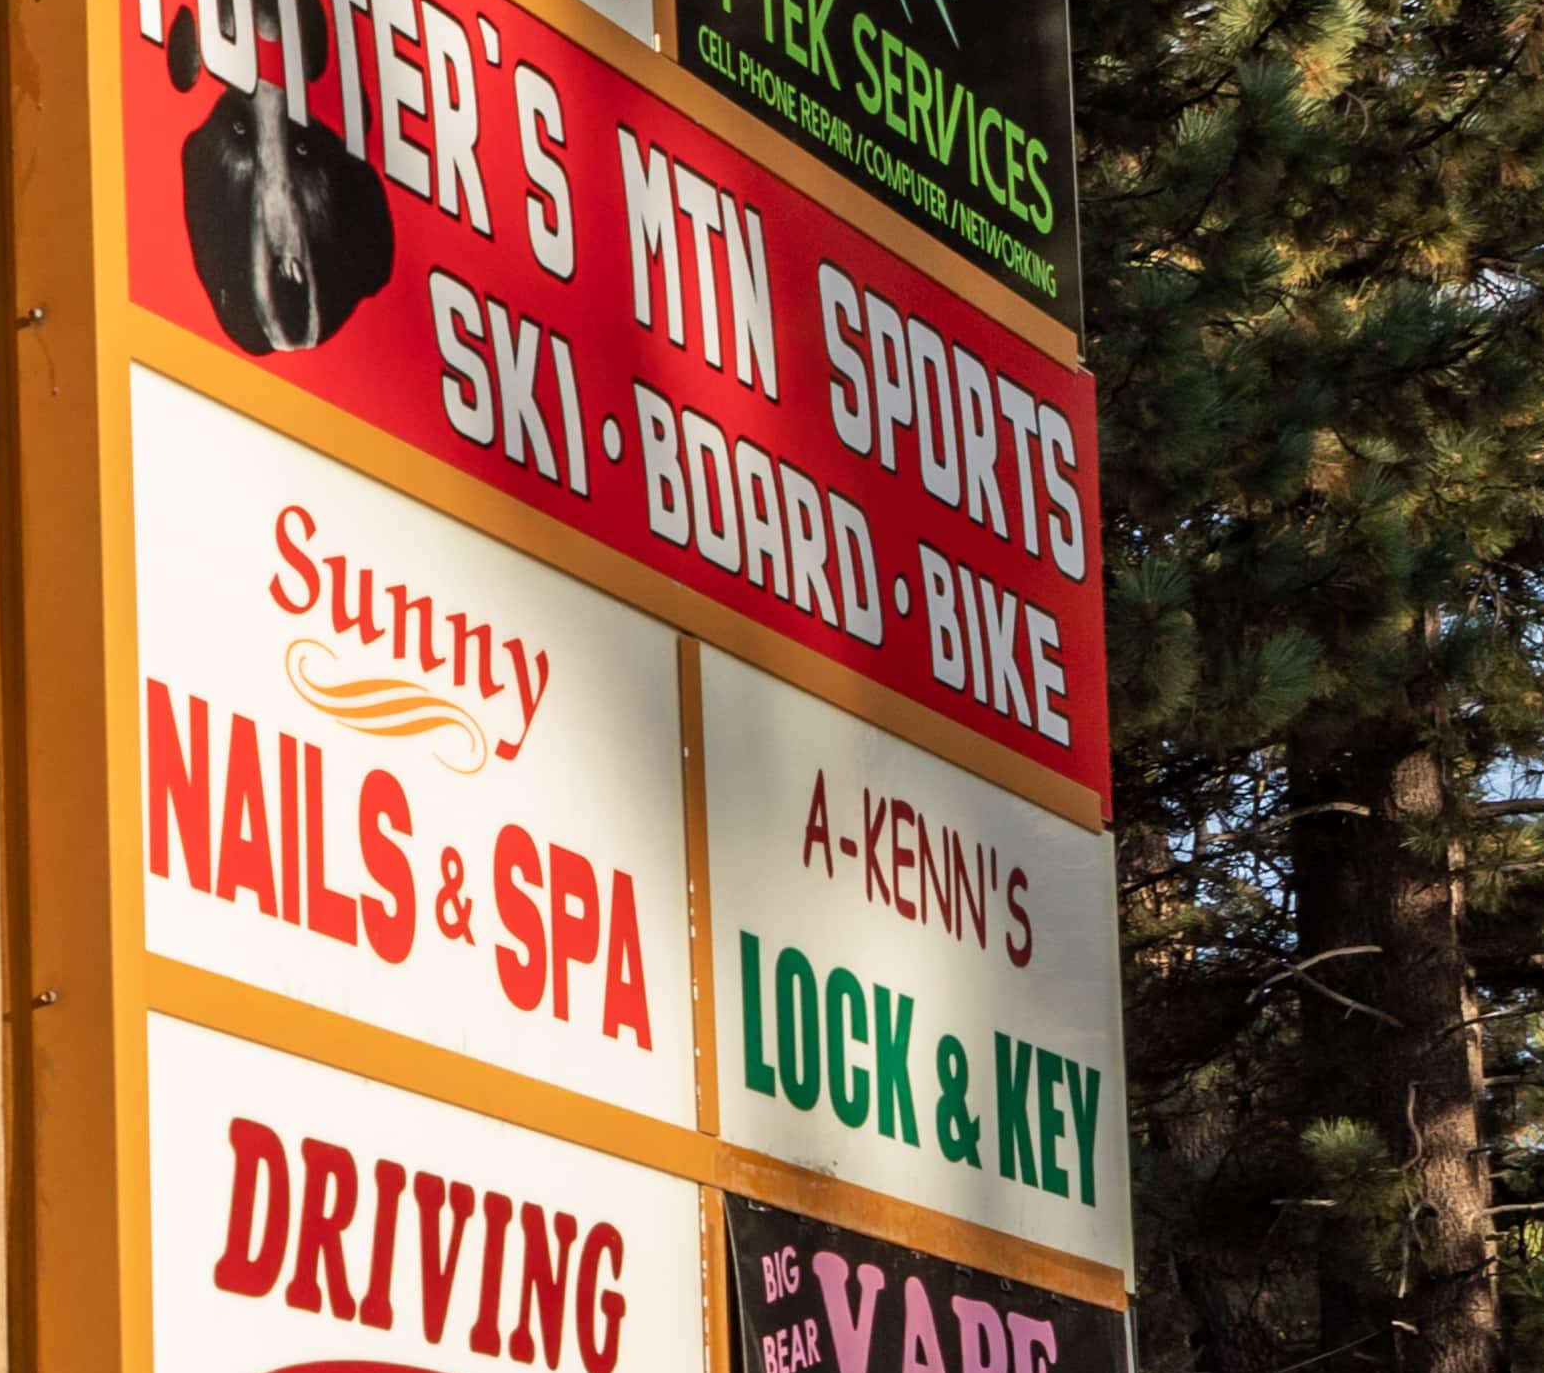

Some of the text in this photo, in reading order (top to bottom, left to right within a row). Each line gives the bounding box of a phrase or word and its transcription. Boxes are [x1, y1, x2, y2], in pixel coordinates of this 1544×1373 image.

[698, 24, 736, 87] CELL
[739, 50, 798, 124] PHONE
[800, 93, 853, 163] REPAIR
[852, 12, 1054, 234] SERVICES
[616, 122, 779, 403] MTN
[816, 258, 1087, 582] SPORTS
[269, 504, 550, 761] Sunny
[146, 676, 653, 1052] NAILS & SPA
[802, 768, 1033, 969] A-KENN'S
[738, 929, 1101, 1209] LOCK & KEY
[761, 1245, 800, 1305] BIG
